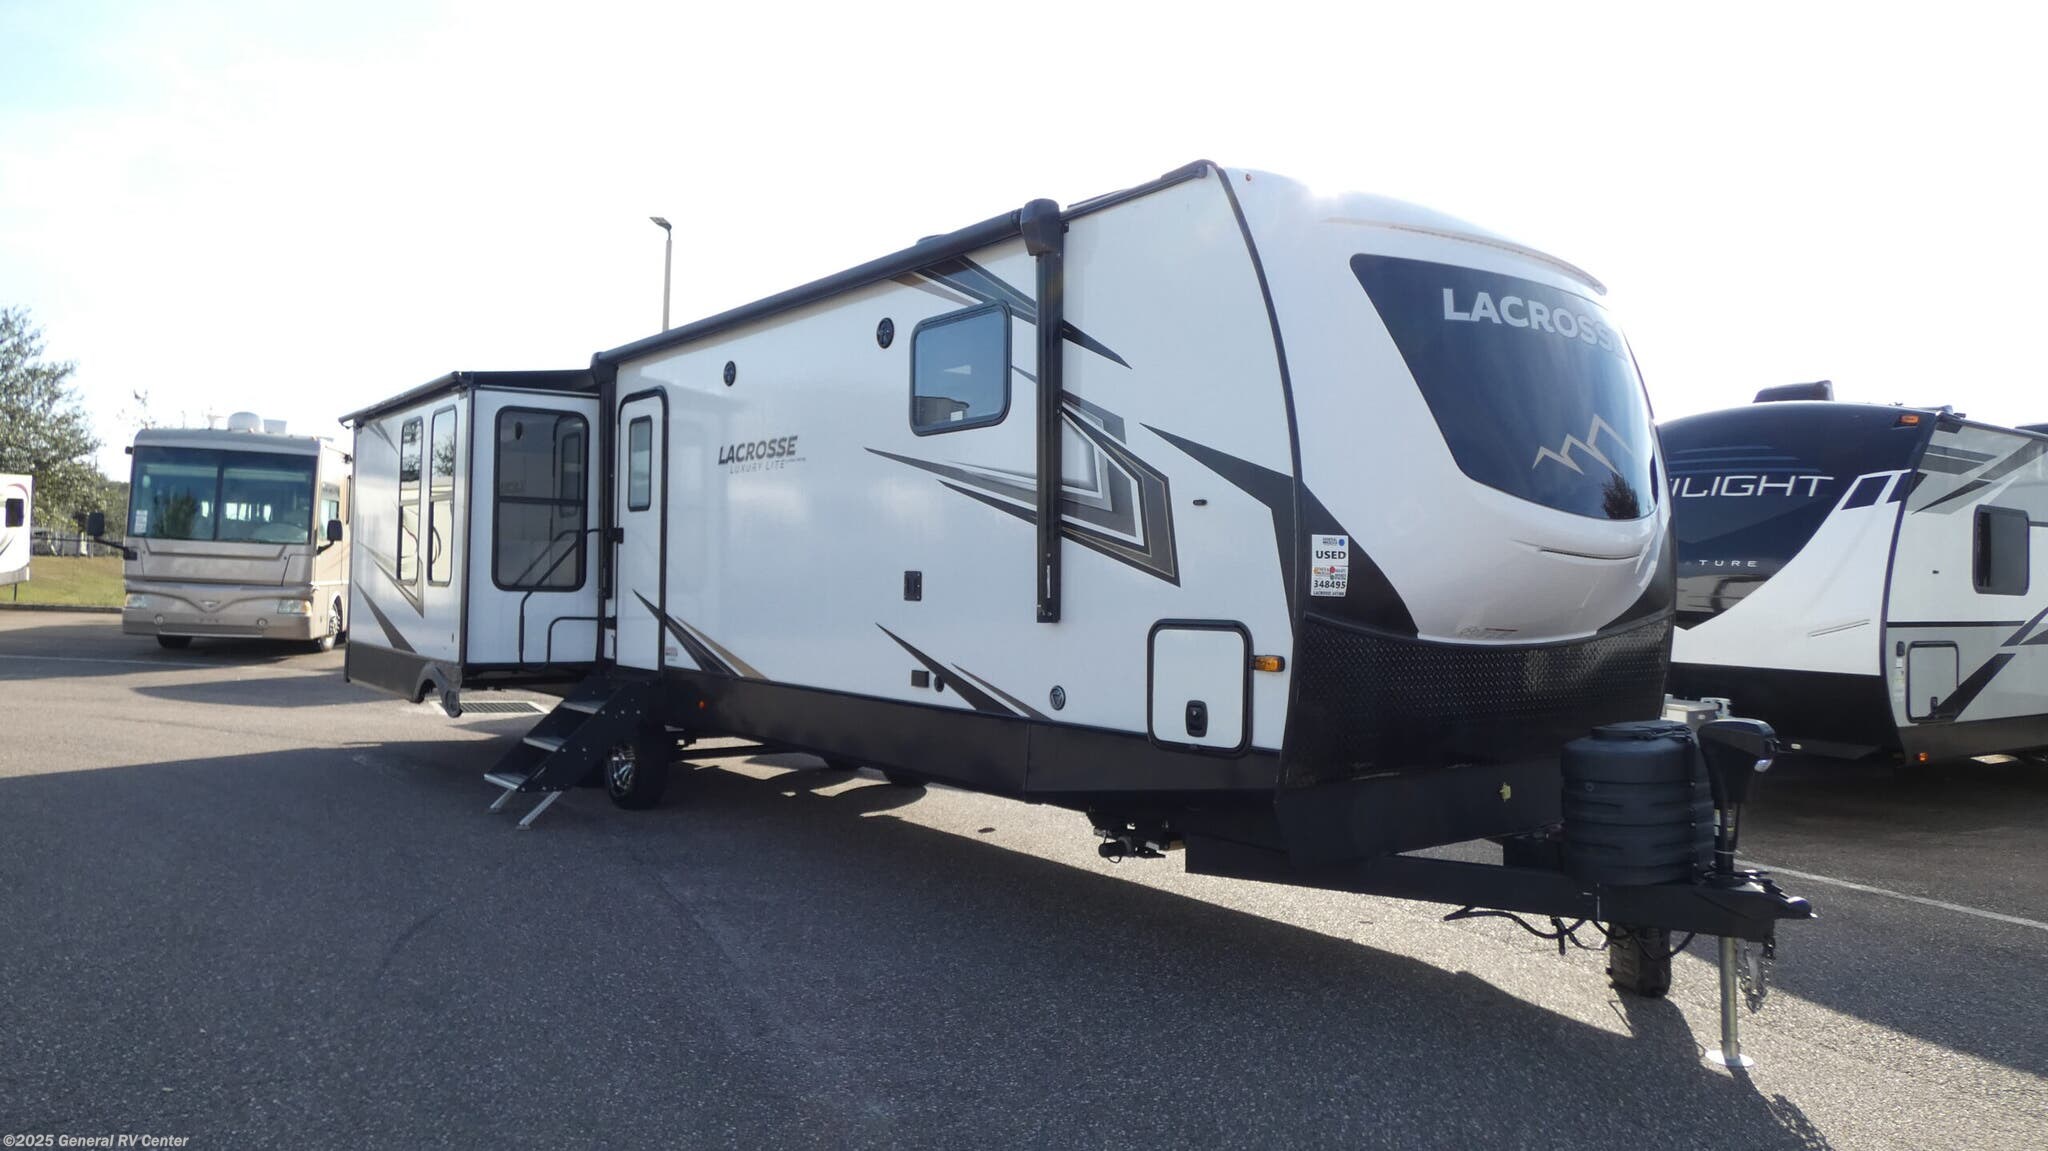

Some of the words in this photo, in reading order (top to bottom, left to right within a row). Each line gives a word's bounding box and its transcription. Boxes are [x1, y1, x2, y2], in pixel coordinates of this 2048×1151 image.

[718, 435, 798, 465] LACROSSE
[729, 462, 762, 475] LUXURY
[765, 459, 785, 471] LITE
[1669, 475, 1835, 497] ILIGHT
[1315, 550, 1347, 560] USED
[1313, 580, 1346, 589] 348495
